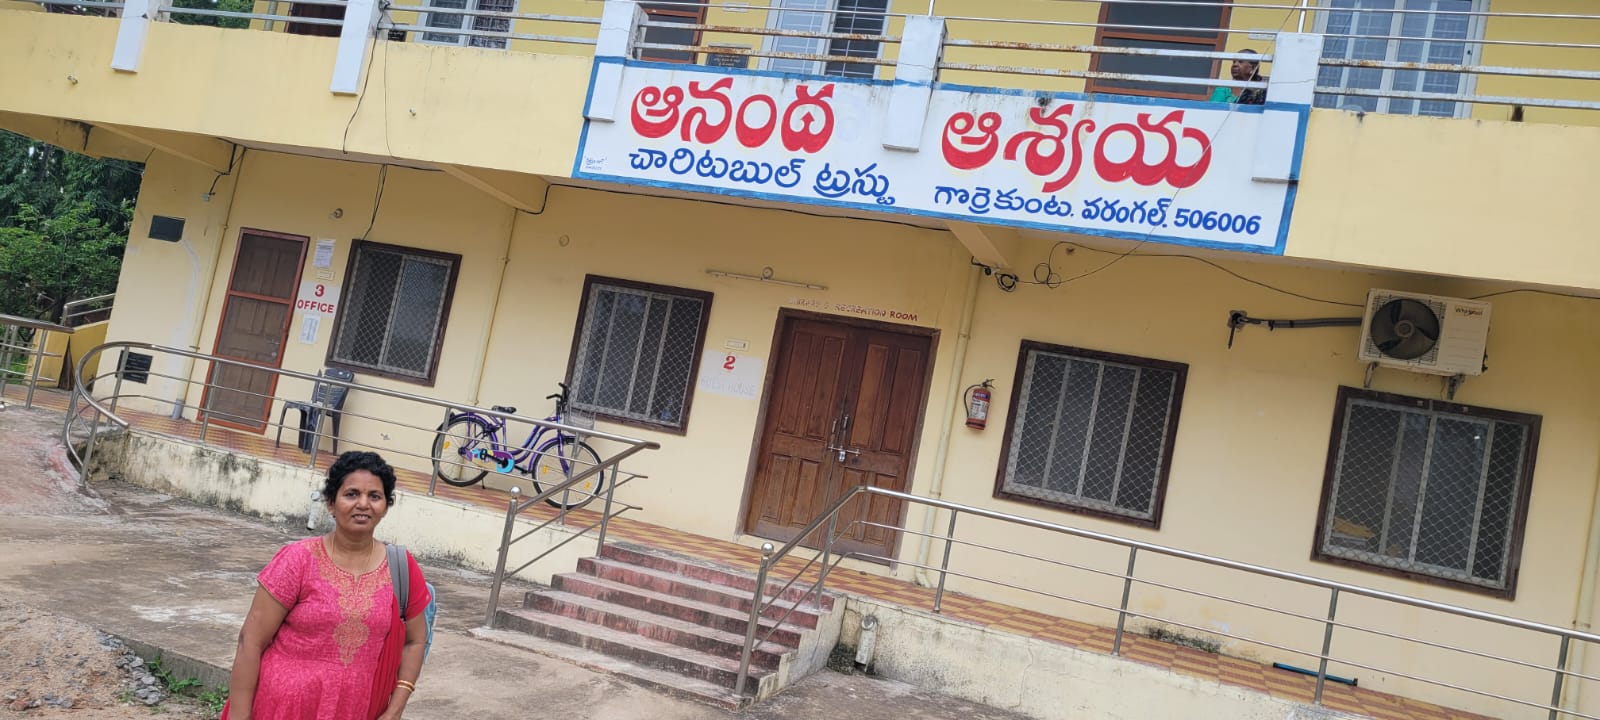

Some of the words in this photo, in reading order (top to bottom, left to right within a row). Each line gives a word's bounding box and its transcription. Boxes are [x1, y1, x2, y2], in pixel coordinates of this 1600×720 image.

[631, 78, 835, 154] ఆనంద
[1173, 208, 1262, 236] 506006
[314, 284, 325, 298] 3
[297, 299, 335, 313] OFFICE
[889, 310, 918, 322] ROOM
[723, 355, 736, 371] 2
